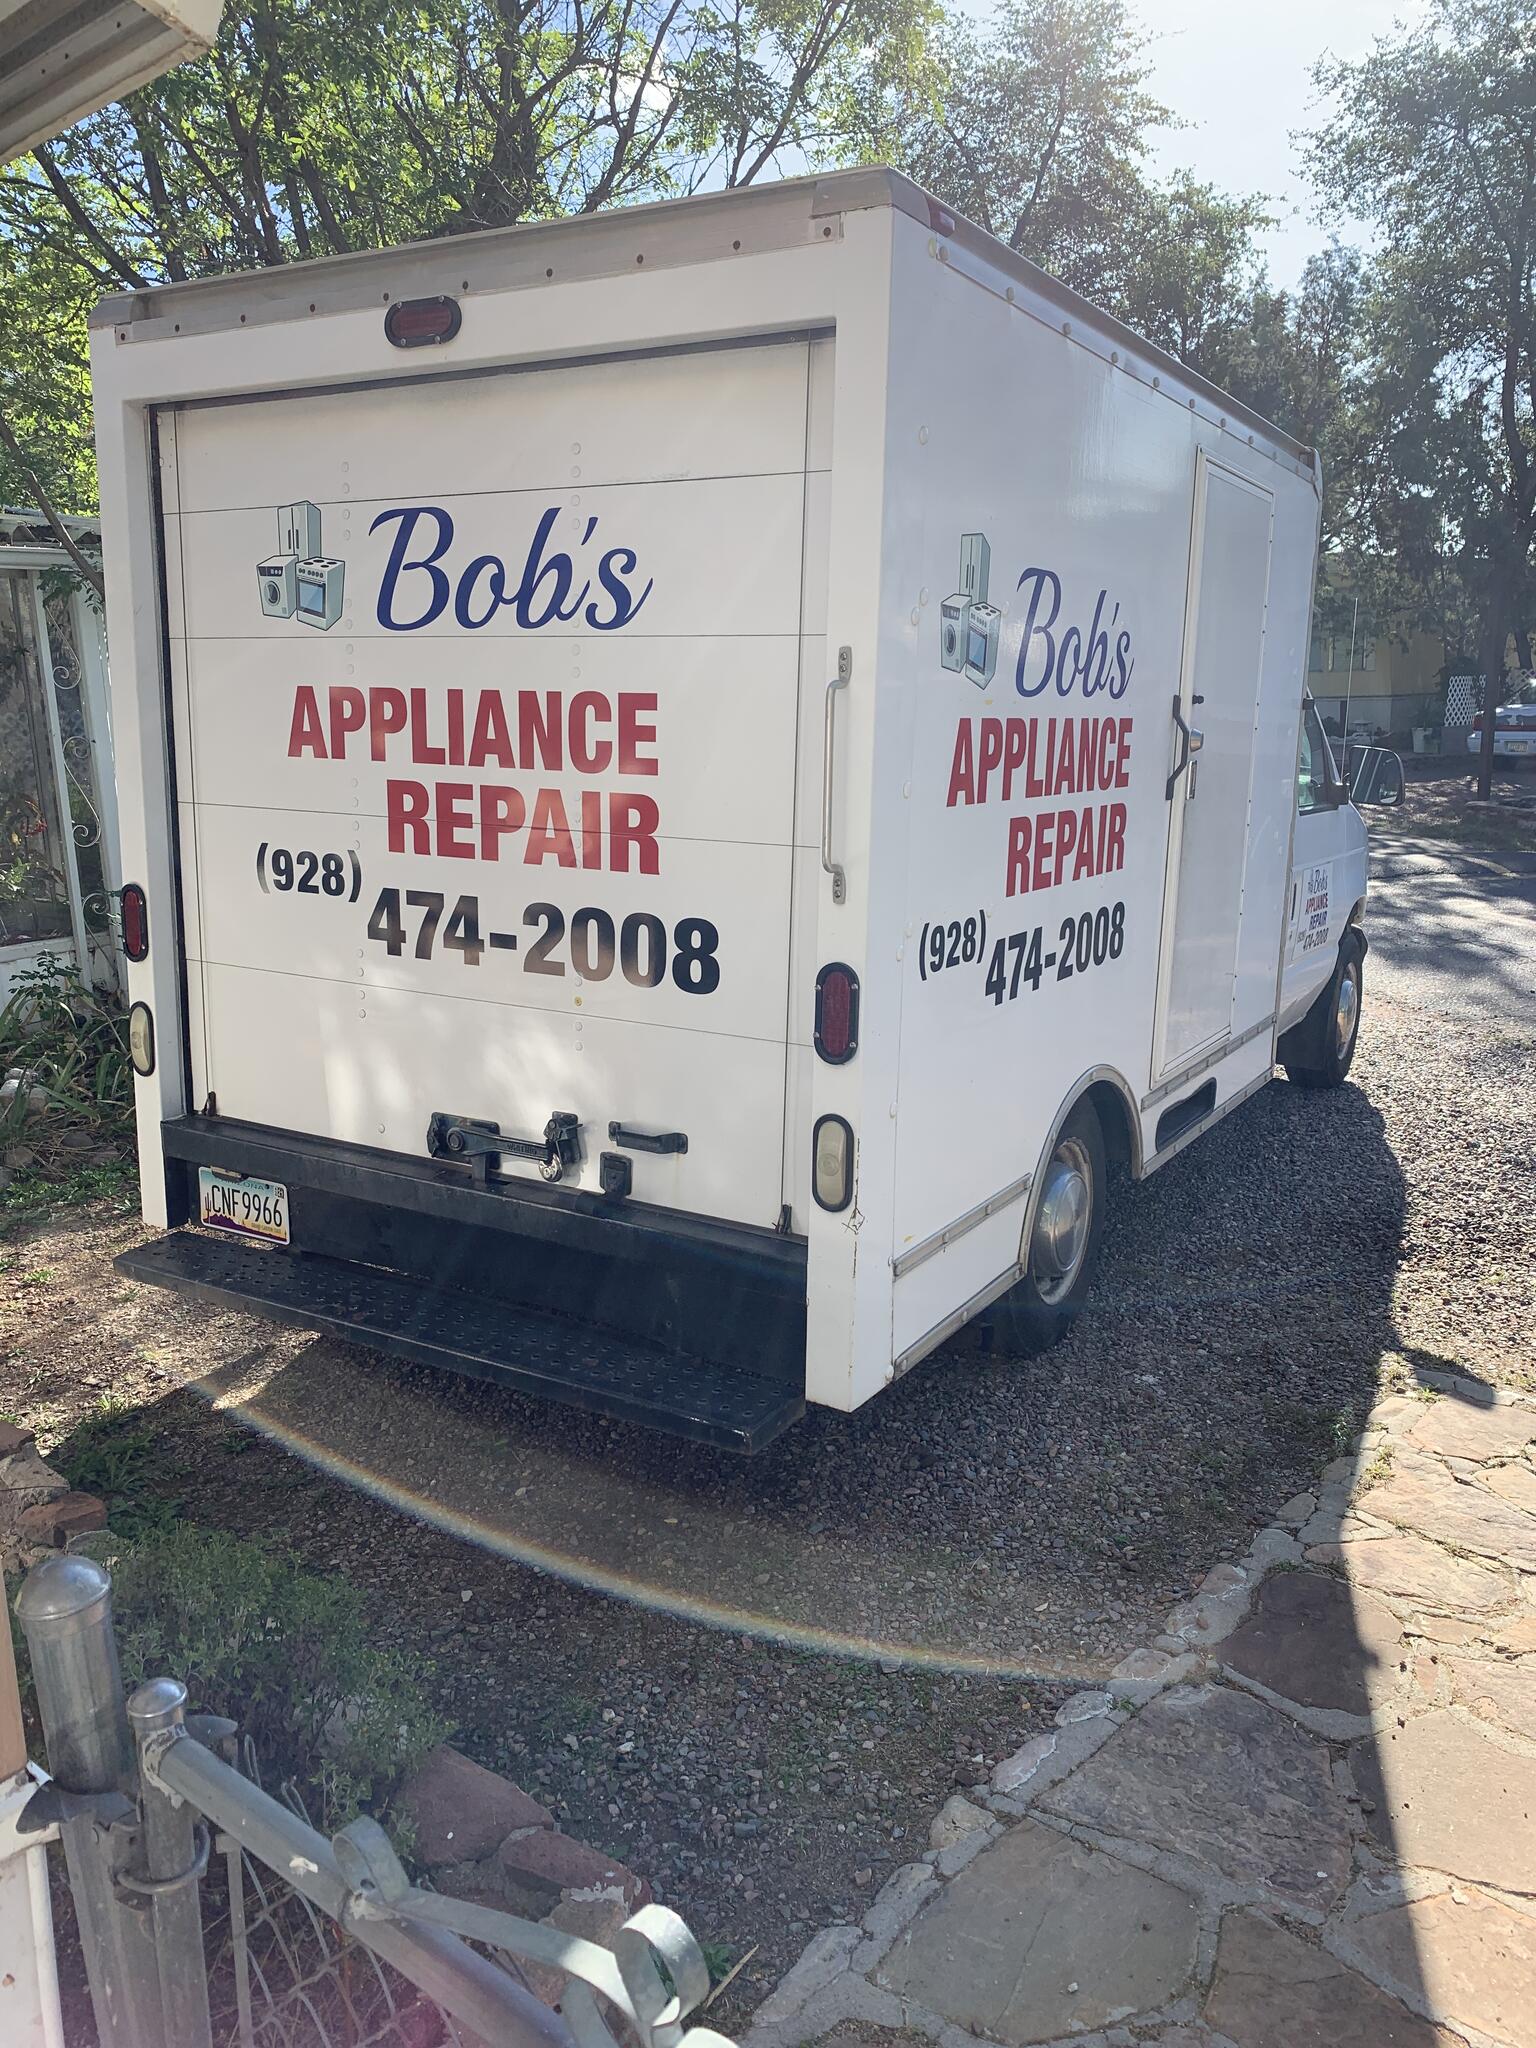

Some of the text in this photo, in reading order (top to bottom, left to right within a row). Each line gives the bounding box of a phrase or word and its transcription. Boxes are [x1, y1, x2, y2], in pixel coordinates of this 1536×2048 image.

[368, 506, 653, 632] Bob's
[1015, 567, 1135, 700] Bob's
[287, 685, 659, 776] APPLIANCE
[946, 717, 1134, 808] APPLIANCE
[386, 778, 660, 876] REPAIR
[1005, 802, 1128, 898] REPAIR
[256, 842, 721, 995] (928) 474-2008
[918, 901, 1126, 1006] (928) 474-2008
